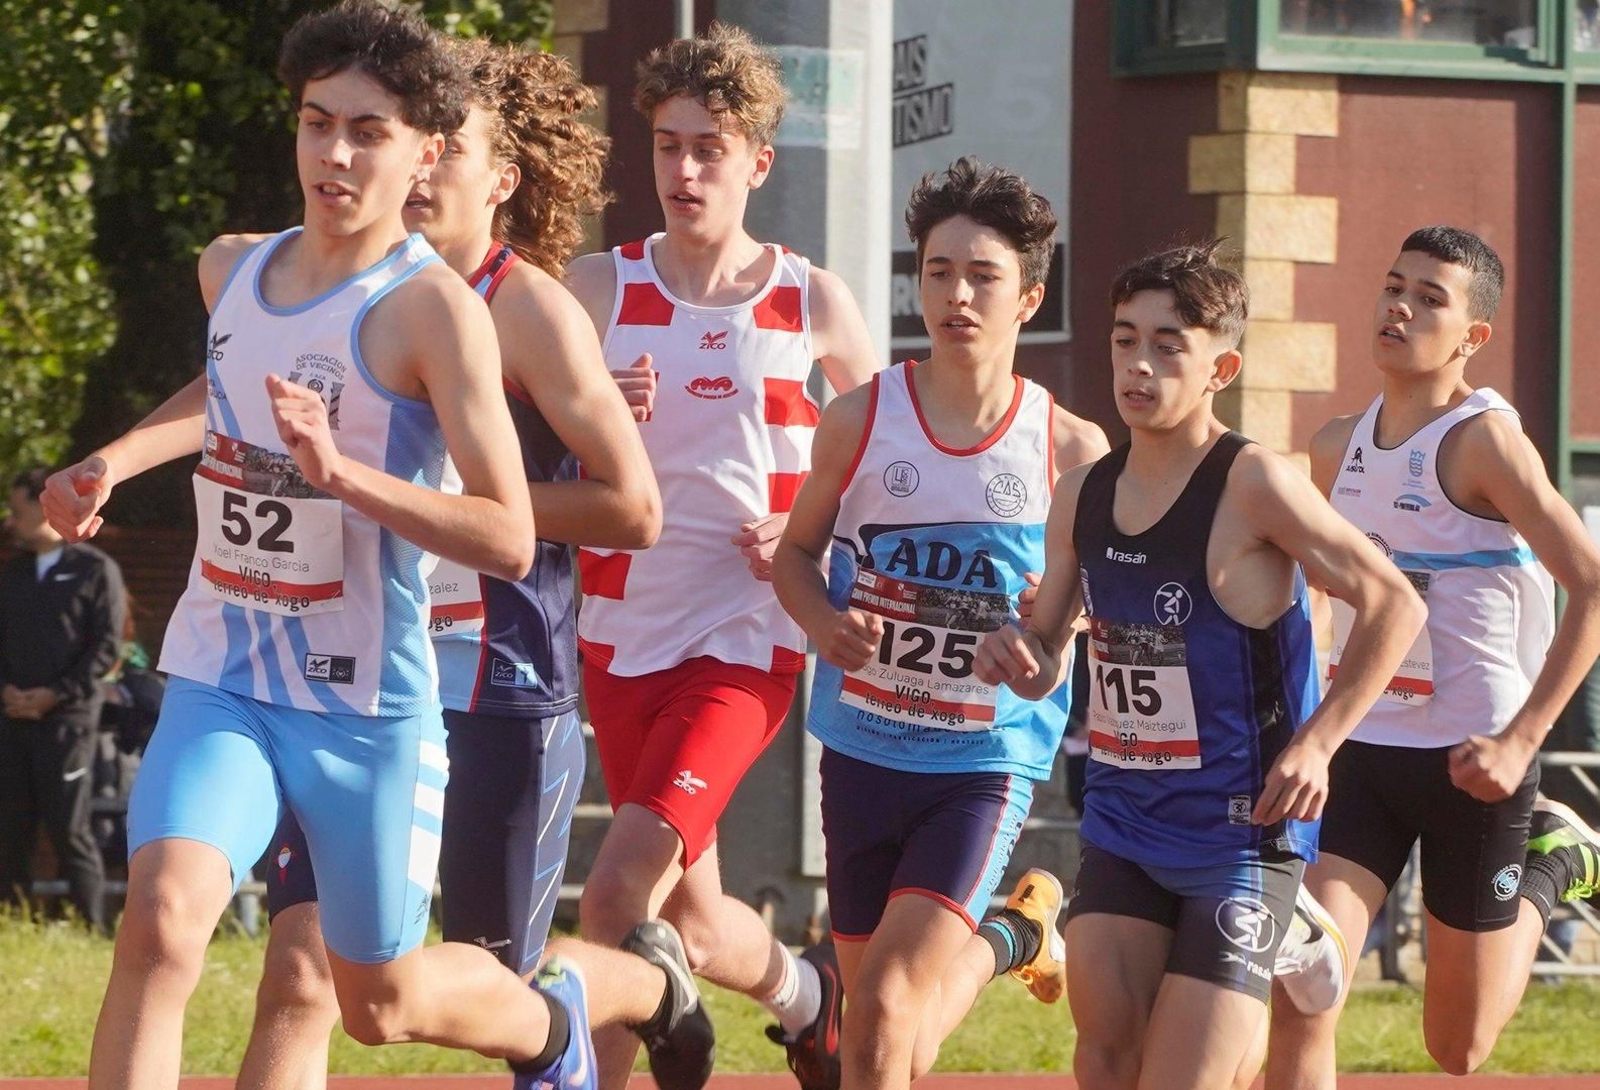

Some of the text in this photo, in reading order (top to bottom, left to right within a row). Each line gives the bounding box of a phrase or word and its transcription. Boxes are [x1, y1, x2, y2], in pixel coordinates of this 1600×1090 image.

[699, 342, 727, 350] ZICO
[221, 491, 294, 553] 52
[234, 549, 268, 568] Franco
[252, 585, 269, 604] de
[275, 592, 310, 612] xogo
[878, 620, 976, 679] 125
[878, 667, 925, 687] Zuluaga
[927, 679, 990, 695] Lamazares
[1096, 664, 1162, 717] 115
[1392, 686, 1414, 701] xogo
[907, 703, 926, 718] de
[931, 708, 966, 726] xogo
[1136, 718, 1187, 734] Maiztegui
[1120, 748, 1136, 762] de
[1141, 751, 1172, 766] xogo
